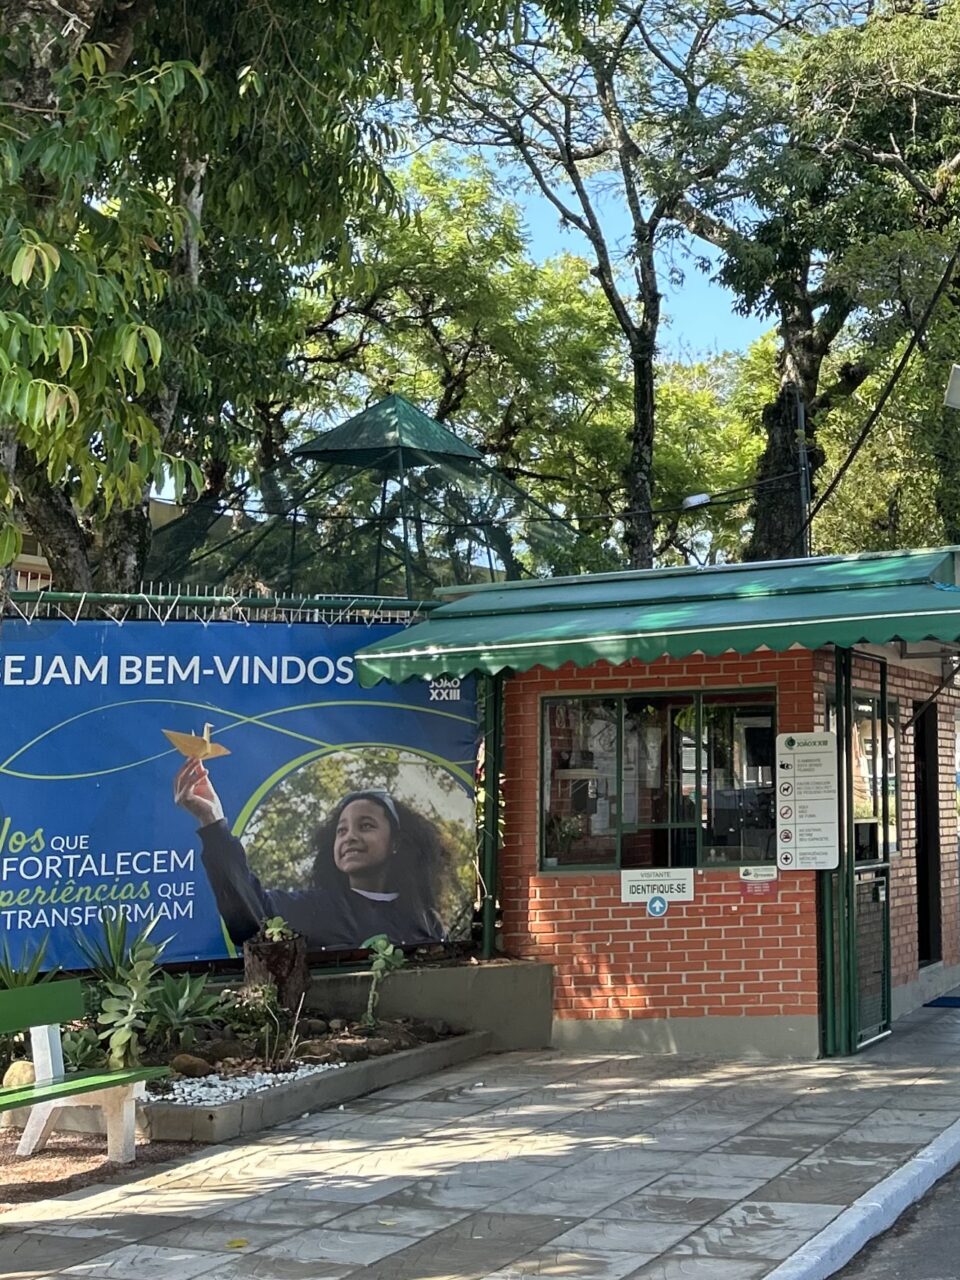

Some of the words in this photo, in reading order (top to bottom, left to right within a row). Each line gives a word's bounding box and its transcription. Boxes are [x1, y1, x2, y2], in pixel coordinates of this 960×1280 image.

[119, 655, 354, 686] BEM-VINDOS
[429, 689, 461, 701] XXIII
[50, 835, 90, 853] QUE
[2, 849, 195, 881] FORTALECEM
[640, 871, 671, 879] VISITANTE
[157, 881, 196, 900] QUE
[629, 883, 687, 896] IDENTIFIQUE-SE
[1, 900, 194, 931] TRANSFORMAM
